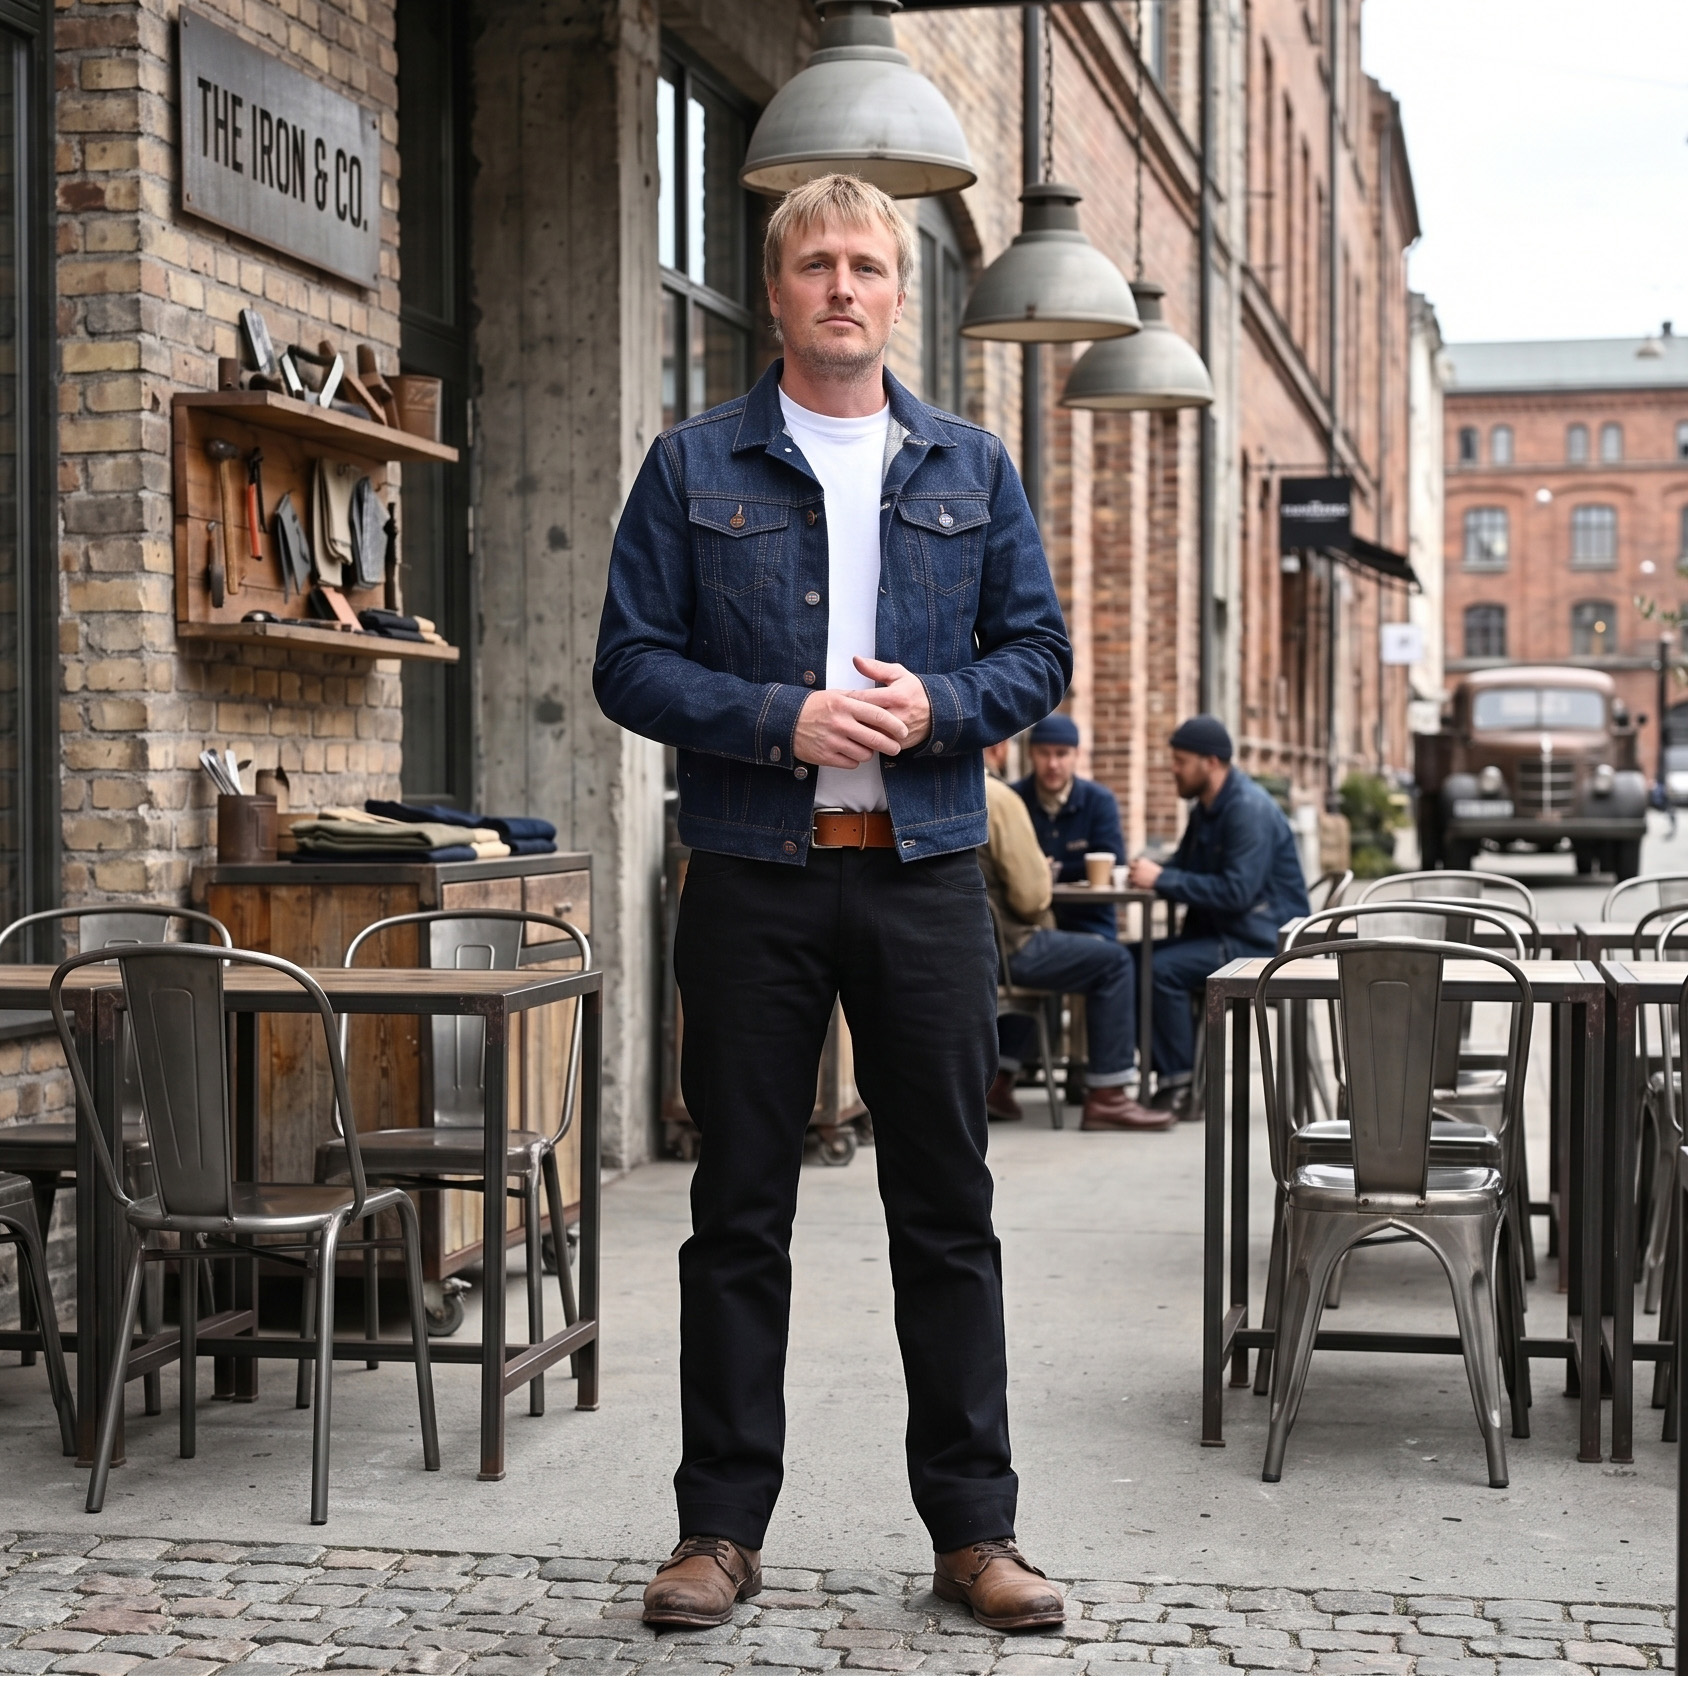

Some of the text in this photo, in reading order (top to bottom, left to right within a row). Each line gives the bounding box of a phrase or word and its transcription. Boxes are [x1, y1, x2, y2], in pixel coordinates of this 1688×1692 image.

[197, 76, 368, 232] THE IRON & CO.
